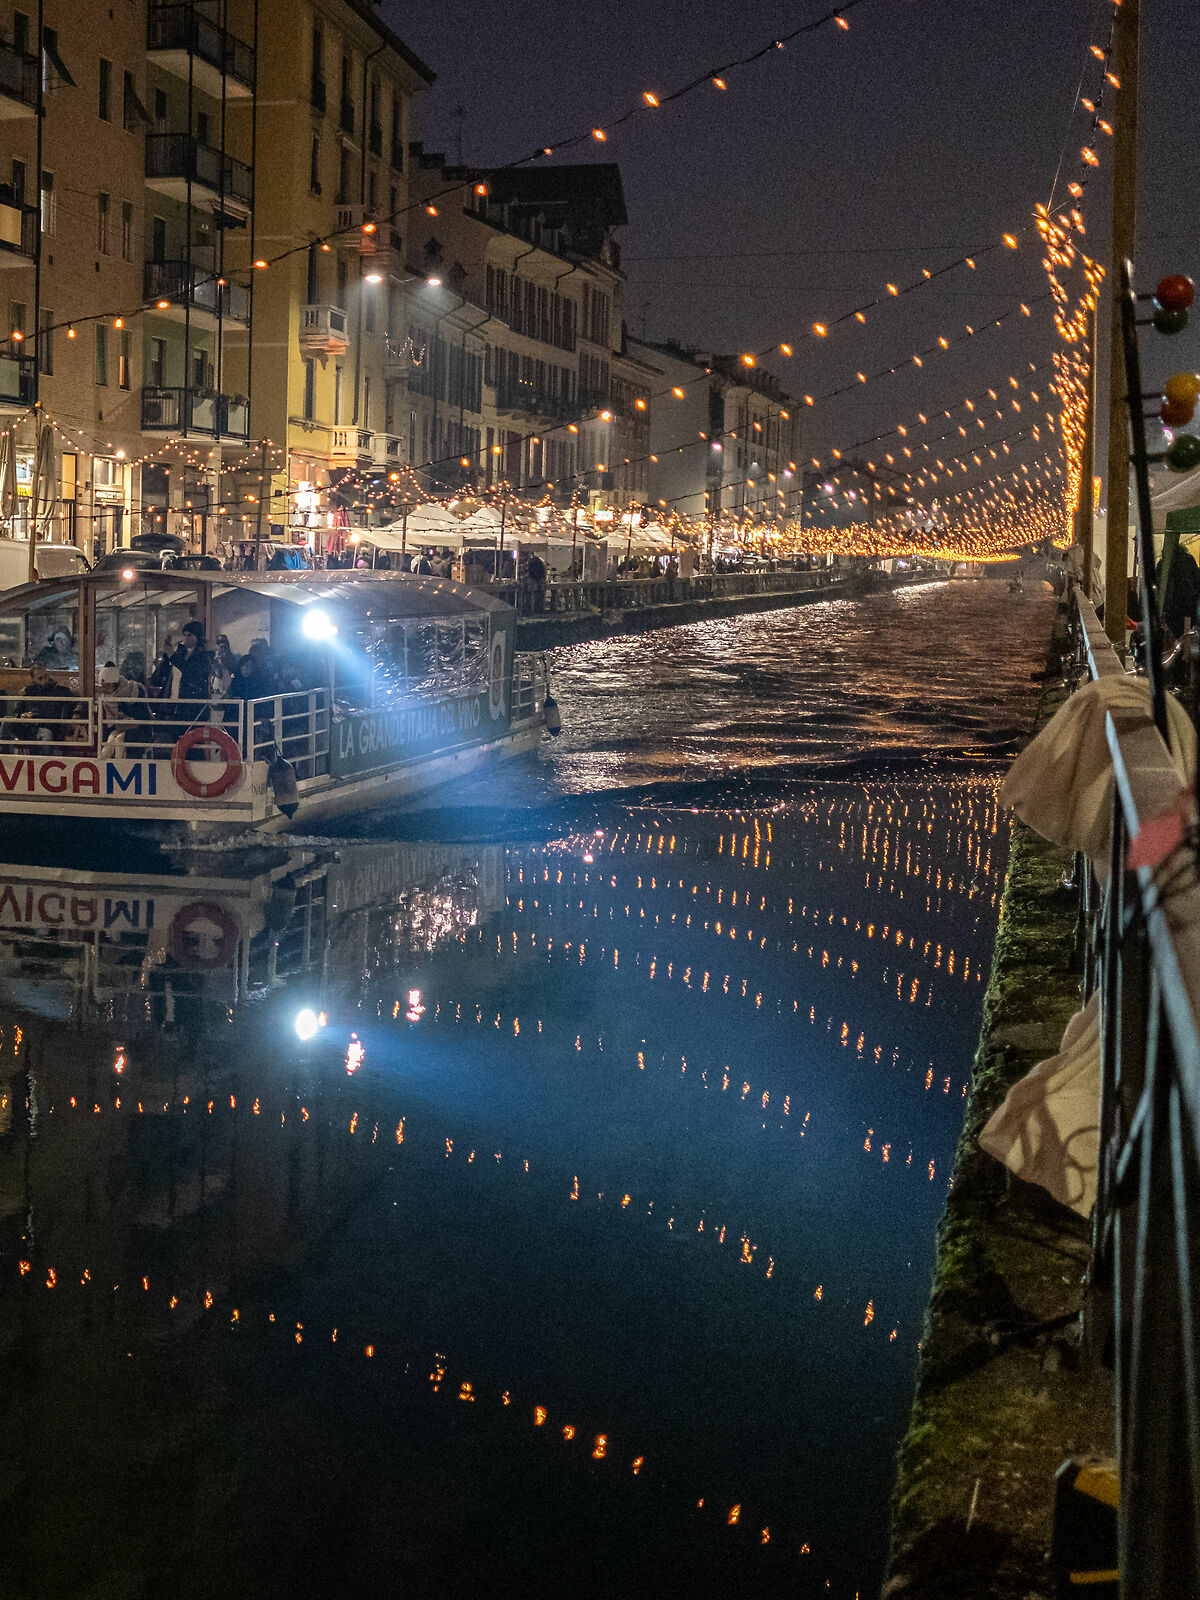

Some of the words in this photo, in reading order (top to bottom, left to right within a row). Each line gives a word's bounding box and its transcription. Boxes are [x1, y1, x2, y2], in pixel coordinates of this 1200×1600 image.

[339, 722, 355, 759] LA
[359, 711, 405, 755] GRANDE
[440, 702, 456, 736] DEL
[458, 697, 481, 731] VINO
